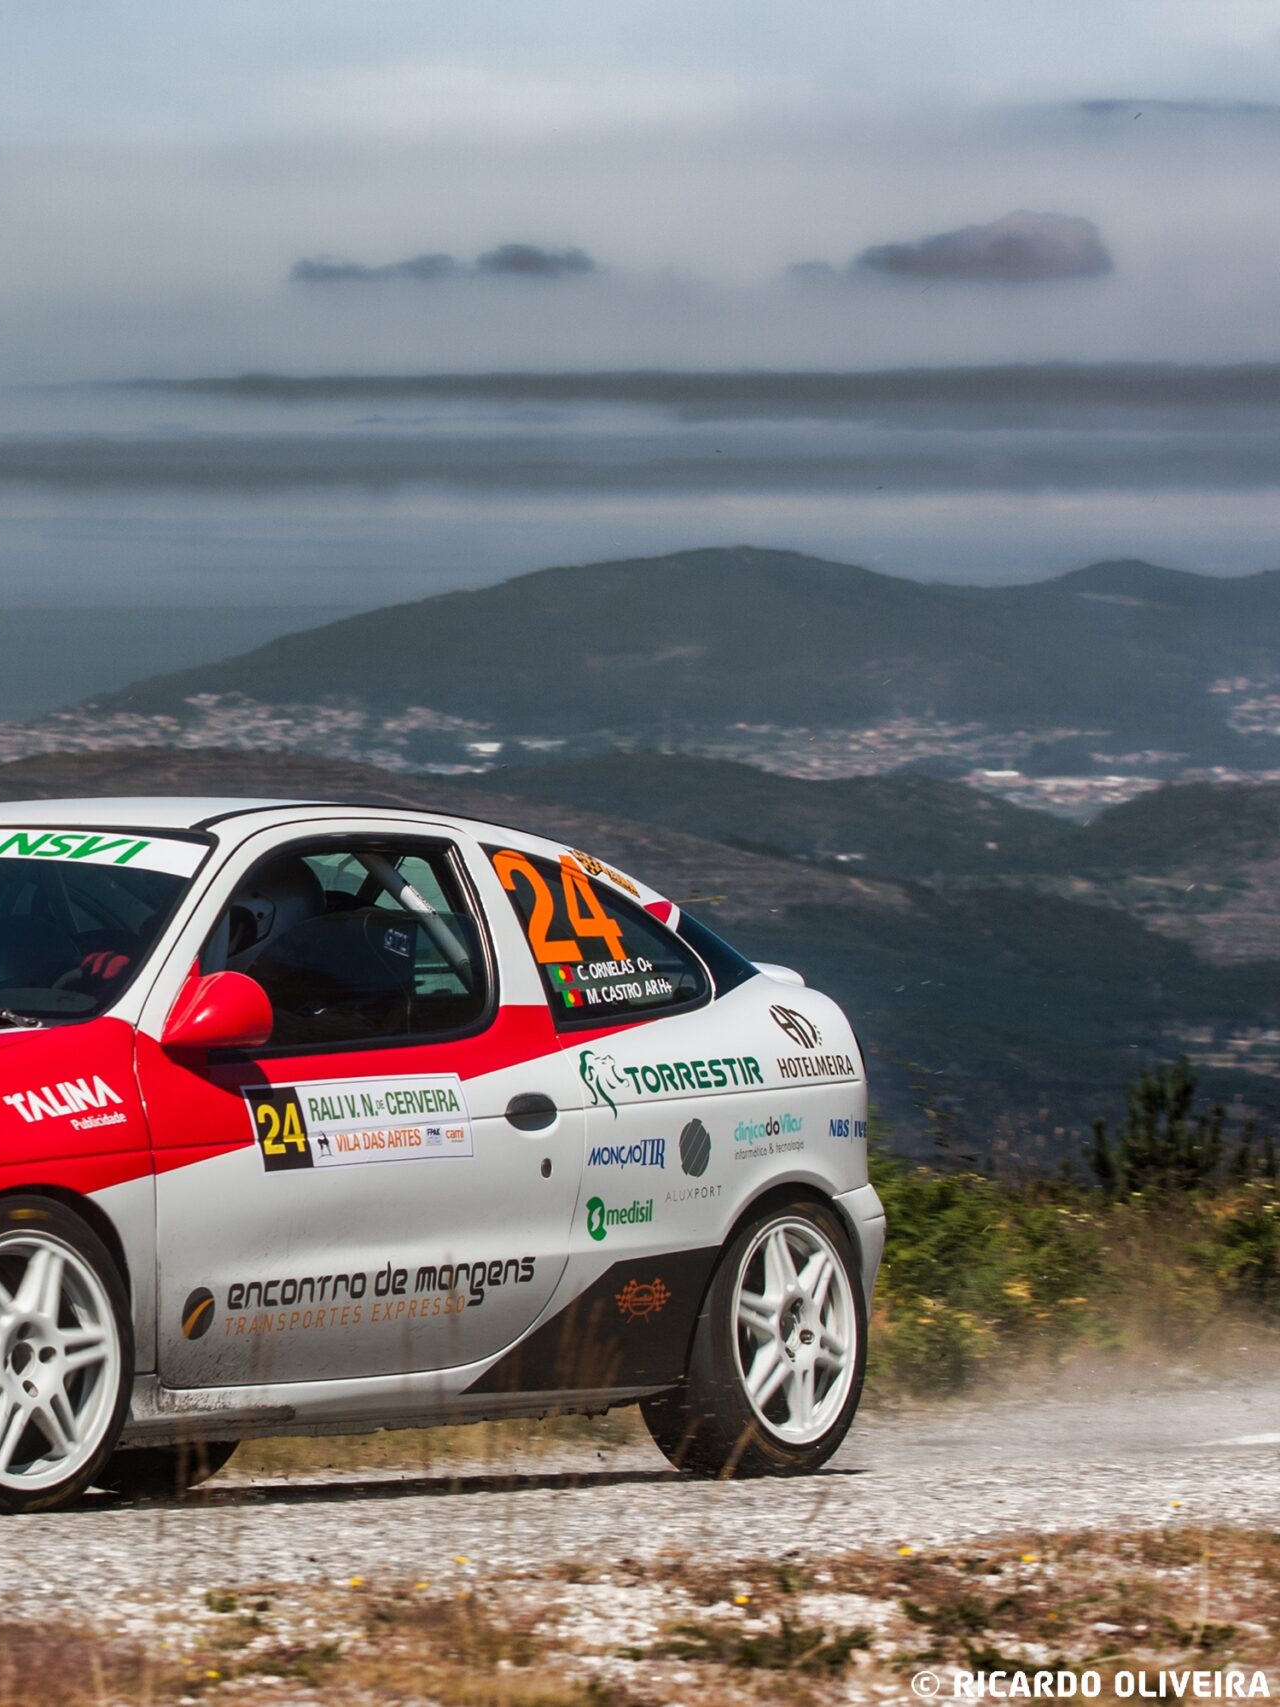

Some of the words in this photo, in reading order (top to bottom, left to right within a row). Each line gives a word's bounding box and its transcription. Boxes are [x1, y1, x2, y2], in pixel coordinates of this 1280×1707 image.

[492, 849, 628, 964] 24
[589, 958, 635, 980] ORNELAS
[636, 957, 653, 973] O+
[585, 987, 602, 1005] M.
[601, 981, 642, 1003] CASTRO
[622, 1056, 764, 1096] TORRESTIR
[2, 1075, 124, 1123] TALINA
[307, 1095, 345, 1122] RALI
[384, 1088, 461, 1117] CERVEIRA
[69, 1111, 127, 1132] Publicidade
[256, 1102, 307, 1156] 24
[828, 1119, 850, 1138] NBS
[334, 1134, 361, 1153] VILA
[361, 1131, 386, 1150] DAS
[386, 1128, 422, 1149] ARTES
[665, 1184, 723, 1204] ALUXPORT
[605, 1199, 654, 1226] medisil
[226, 1272, 367, 1310] encontro
[374, 1260, 408, 1298] de
[414, 1256, 537, 1307] margens
[224, 1304, 362, 1337] TRANSPORTES
[370, 1294, 467, 1323] EXPRESSO
